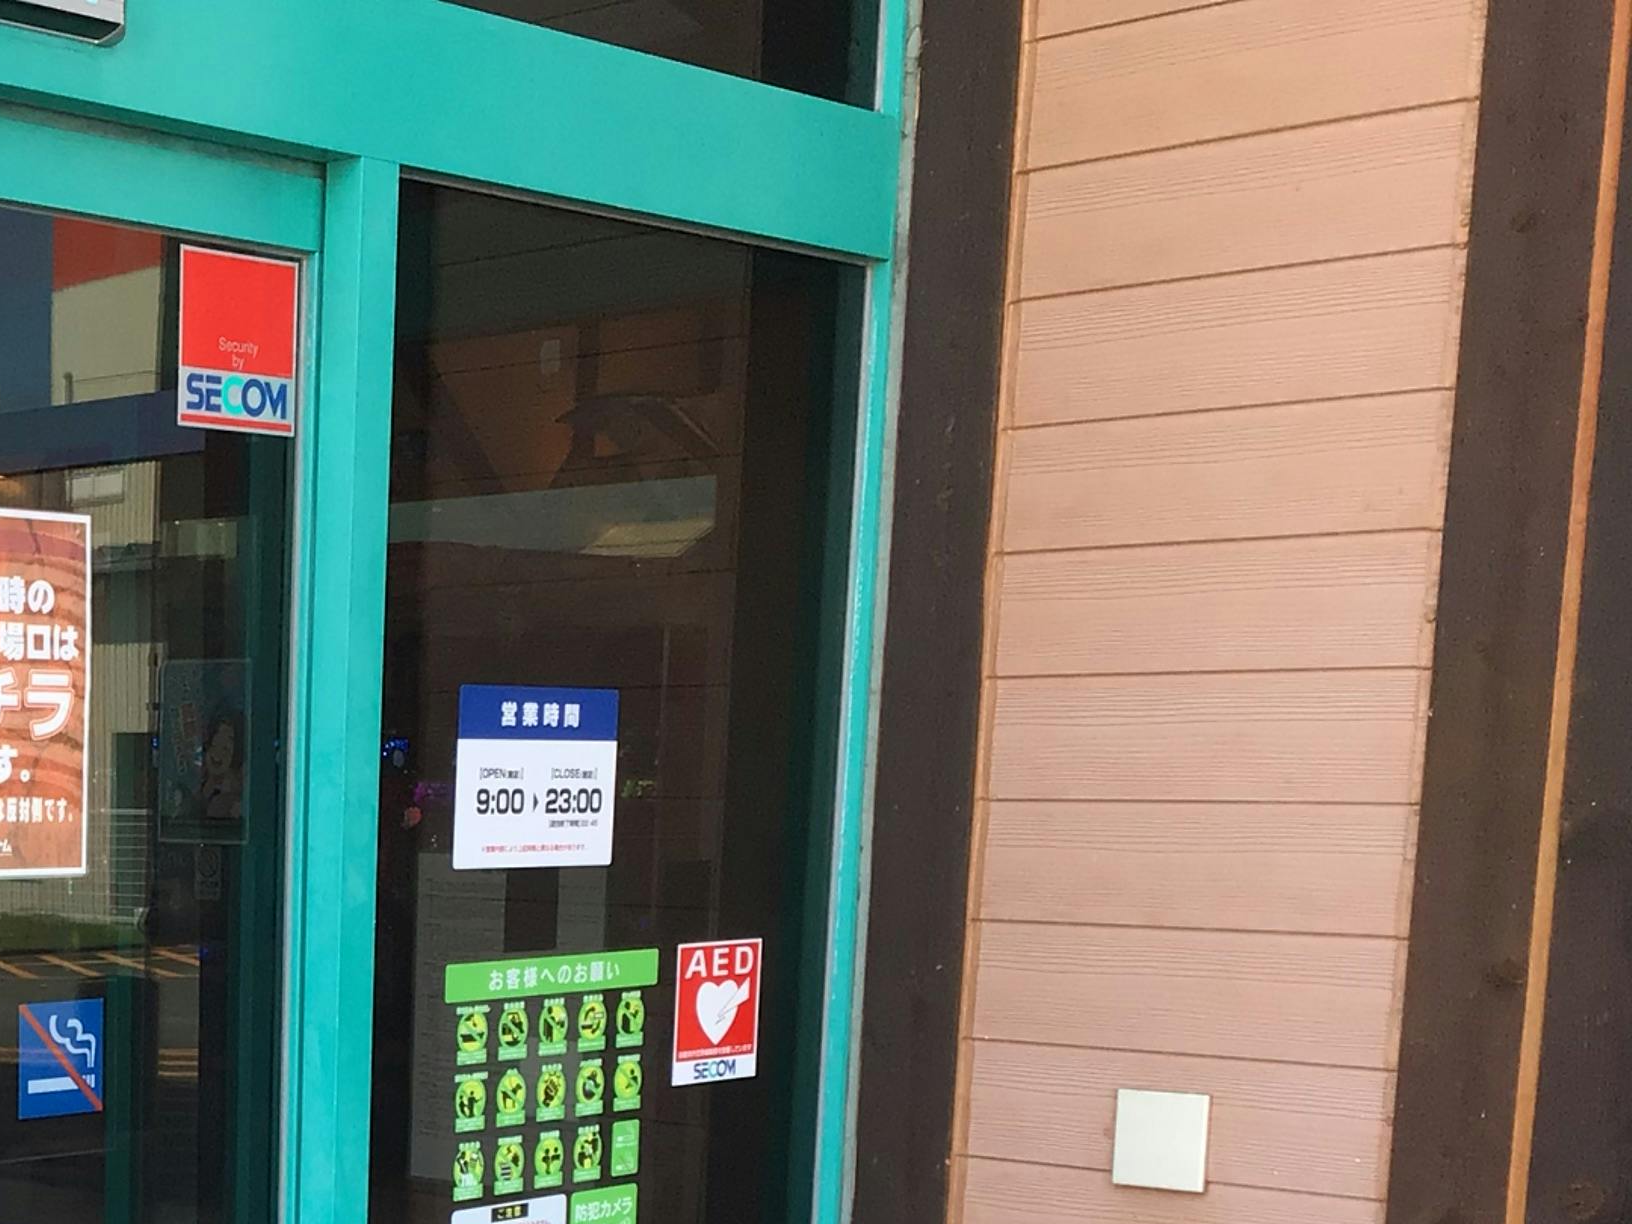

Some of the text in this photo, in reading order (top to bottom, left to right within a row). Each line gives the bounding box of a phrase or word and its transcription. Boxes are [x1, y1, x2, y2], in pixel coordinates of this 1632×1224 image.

[218, 336, 259, 359] Security
[231, 353, 245, 371] by
[186, 372, 288, 420] SECOM
[500, 701, 581, 728] 営業時間
[476, 788, 603, 815] 9:00 23:00
[488, 960, 621, 991] お客様へのお願い
[684, 945, 754, 980] AED
[693, 1059, 736, 1080] SECOM
[575, 1196, 633, 1223] 防犯カメラ
